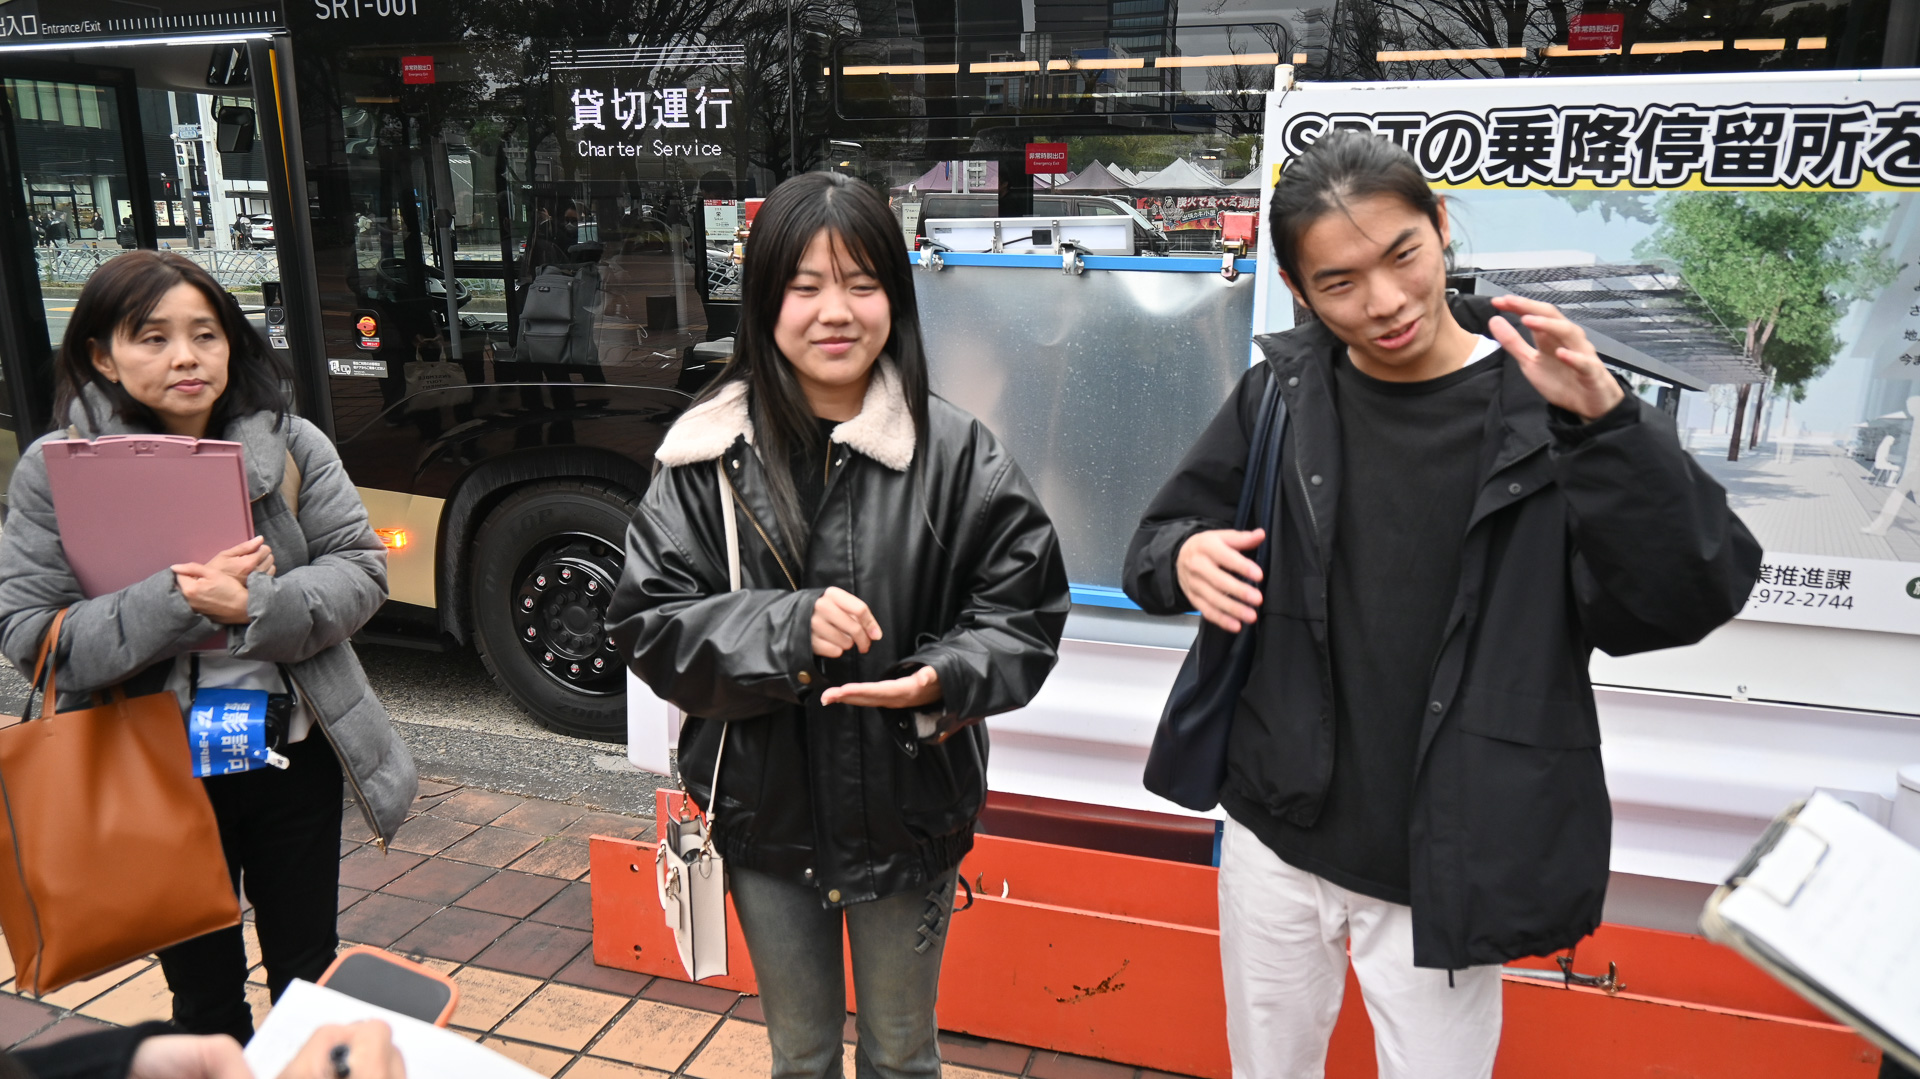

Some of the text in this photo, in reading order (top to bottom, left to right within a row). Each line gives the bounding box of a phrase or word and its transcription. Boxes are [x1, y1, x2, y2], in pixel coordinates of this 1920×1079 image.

[41, 20, 102, 35] Entrance/Exit
[571, 86, 733, 131] 貸切運行
[577, 139, 722, 157] Charter Service
[1028, 152, 1065, 160] 非常時脱出口
